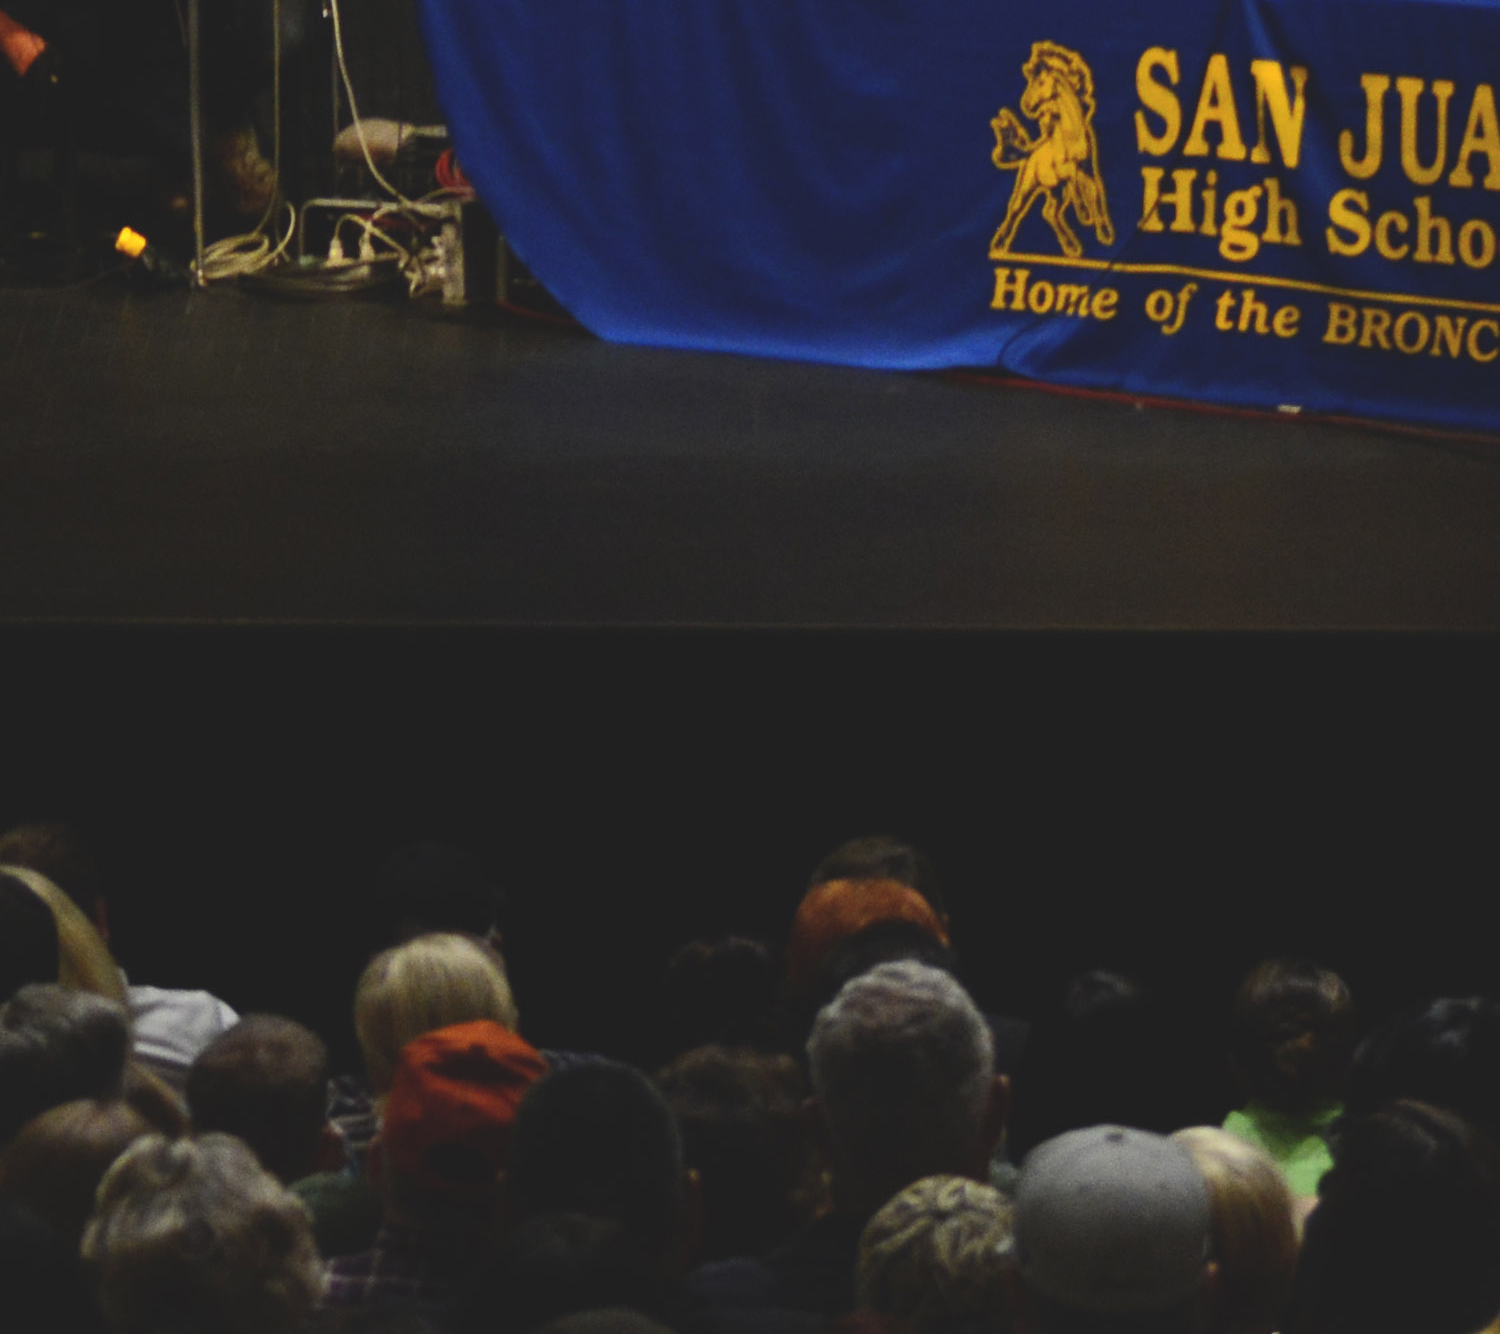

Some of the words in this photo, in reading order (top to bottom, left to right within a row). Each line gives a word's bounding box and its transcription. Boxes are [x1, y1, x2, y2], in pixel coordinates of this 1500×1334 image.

[1133, 46, 1308, 169] SAN
[1139, 167, 1302, 262] High
[990, 266, 1118, 322] Home
[1145, 282, 1197, 336] of
[1214, 287, 1300, 338] the
